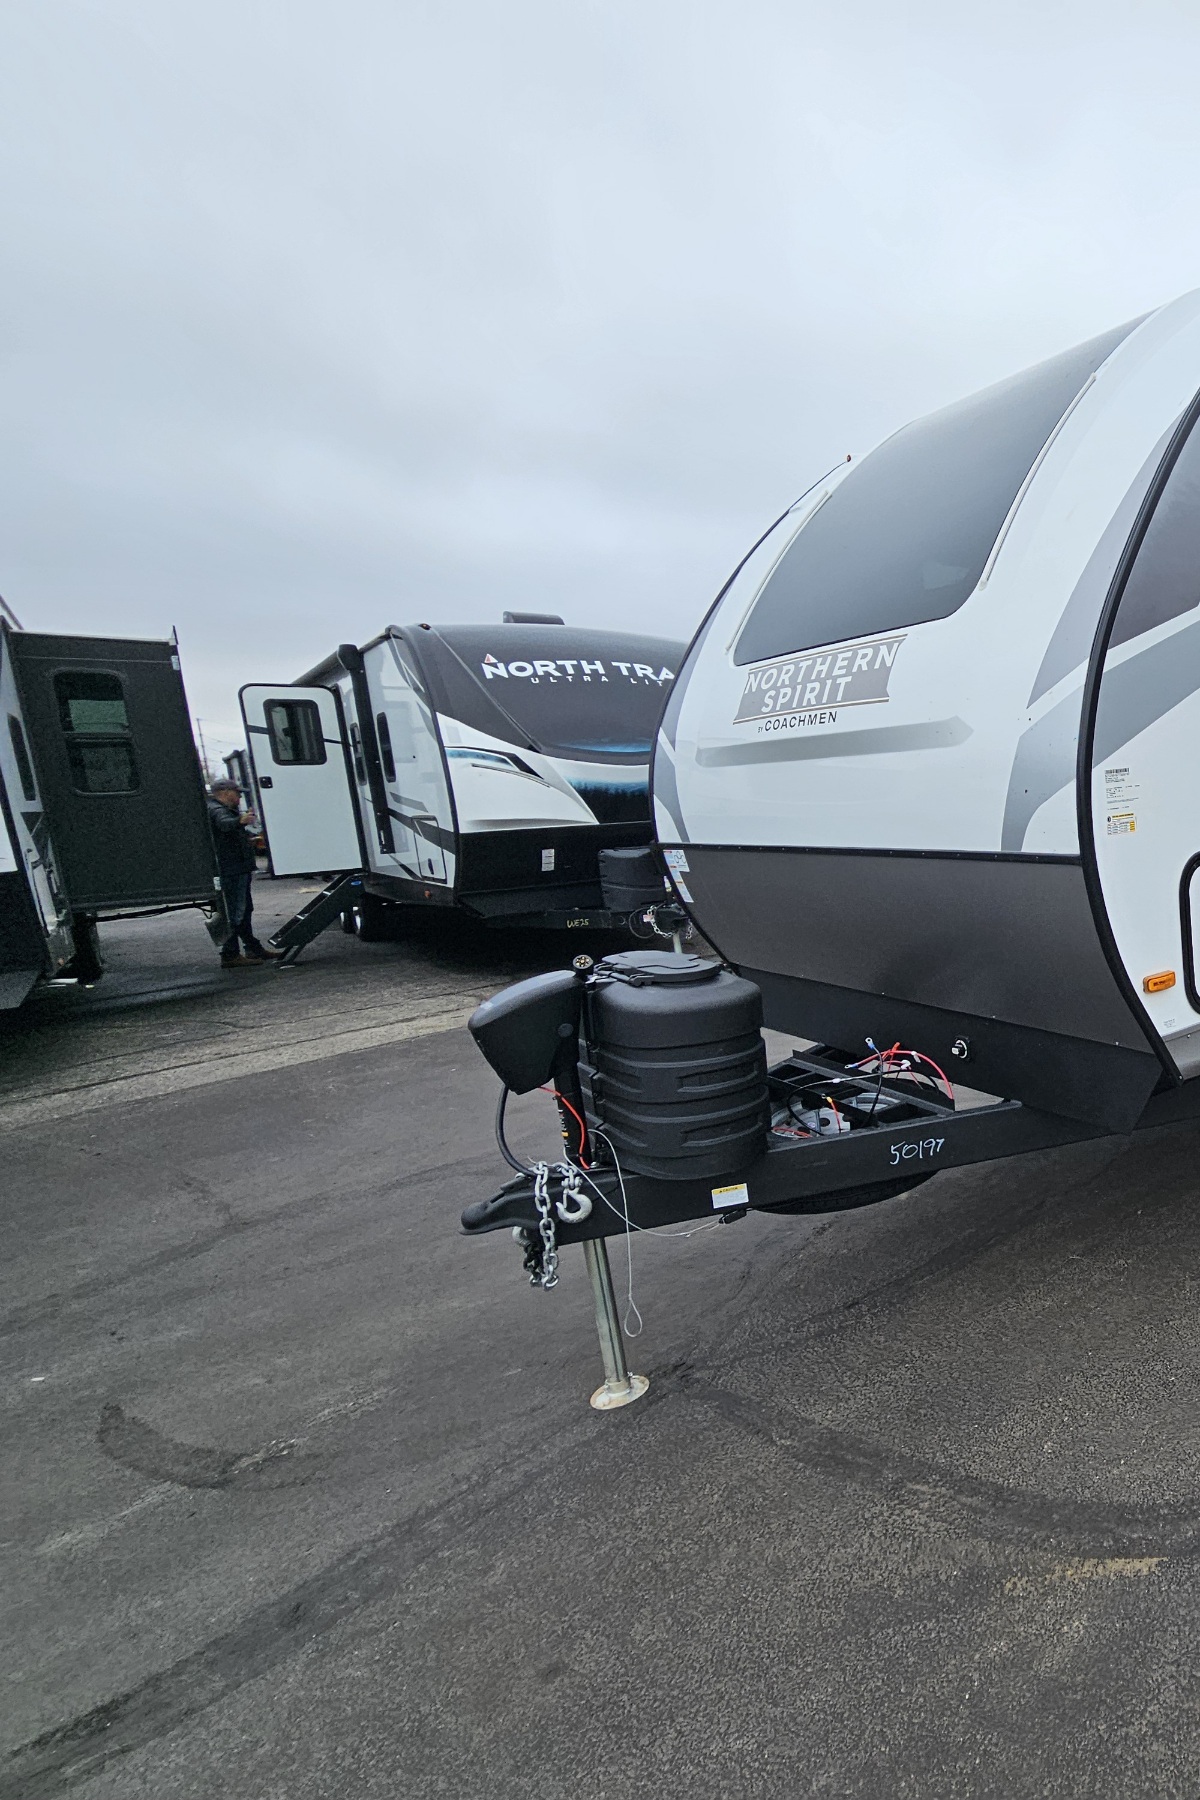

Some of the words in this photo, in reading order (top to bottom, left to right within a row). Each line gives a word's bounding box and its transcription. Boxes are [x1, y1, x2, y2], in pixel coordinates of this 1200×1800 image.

[481, 660, 606, 679] NORTH
[531, 675, 609, 684] ULTRA
[745, 643, 899, 694] NORTHERN
[761, 675, 852, 713] SPIRIT
[765, 711, 838, 732] COACHMEN
[890, 1138, 945, 1165] 50197
